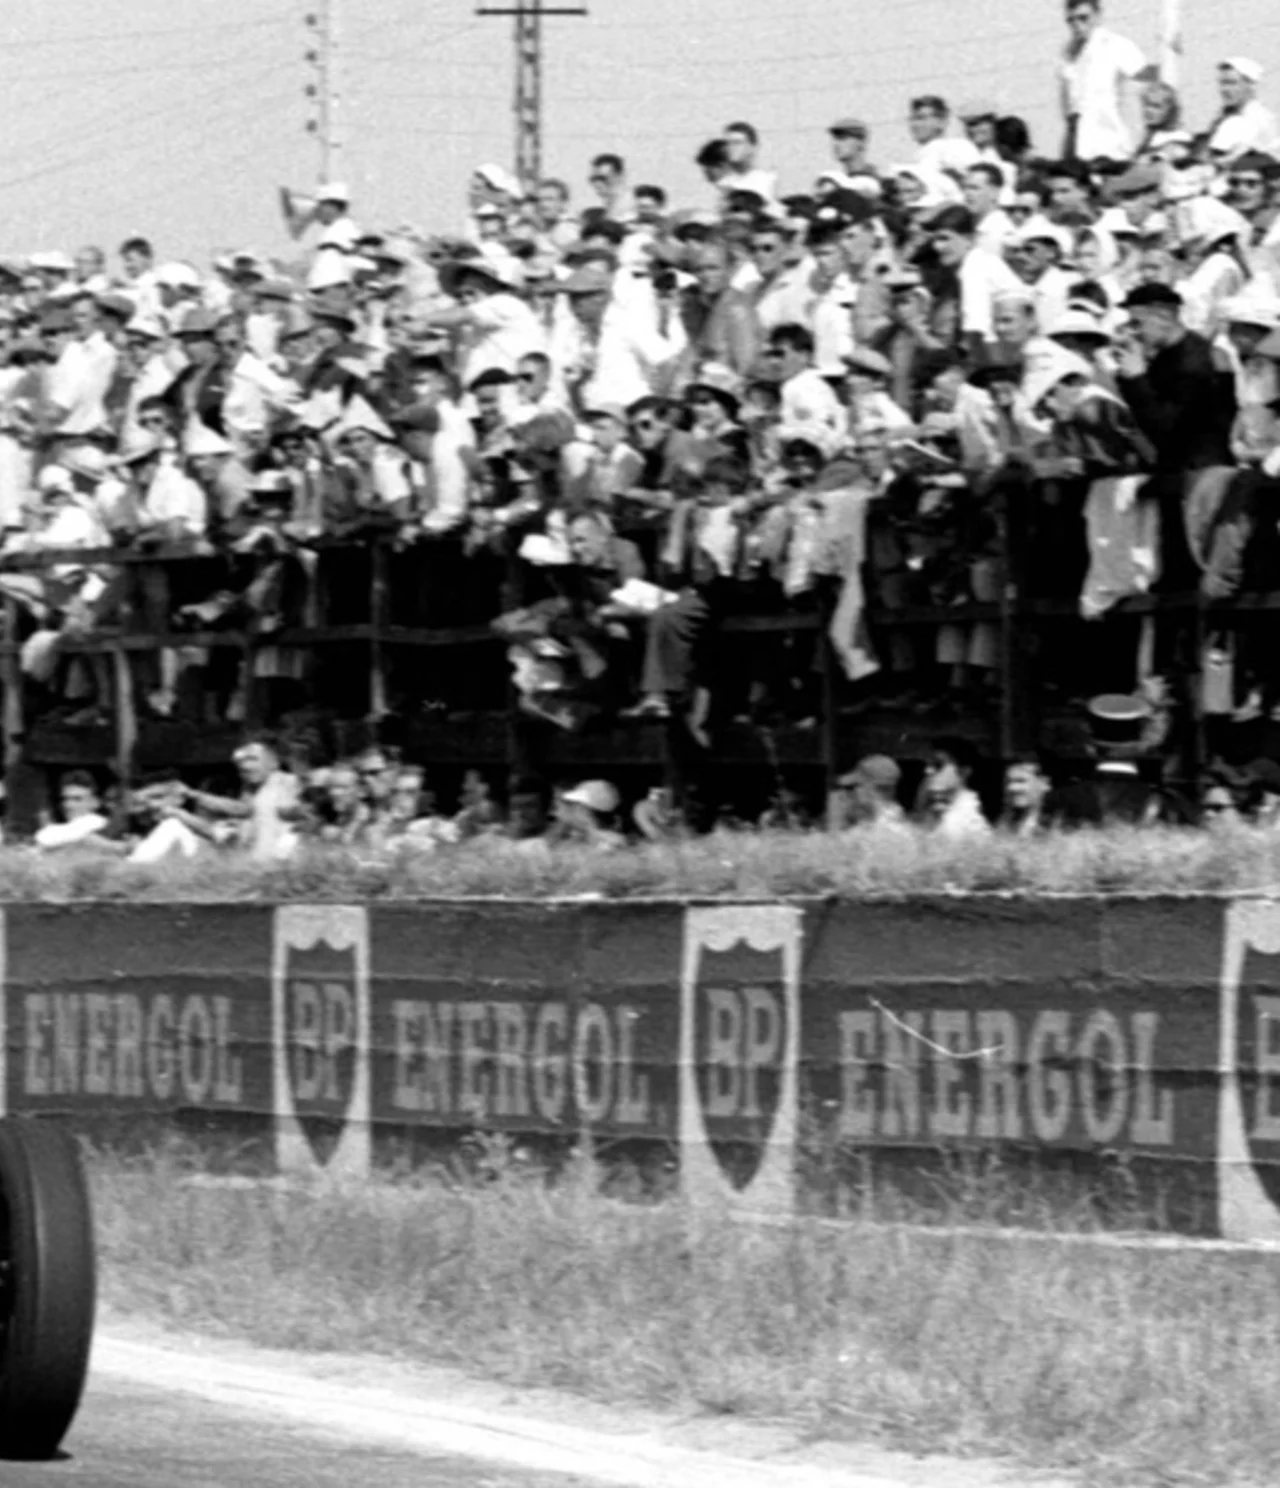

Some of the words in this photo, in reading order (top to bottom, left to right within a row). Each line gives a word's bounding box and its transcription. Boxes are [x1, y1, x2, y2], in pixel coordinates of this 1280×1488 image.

[24, 994, 240, 1101] ENERGOL
[292, 983, 354, 1100] BP
[393, 1000, 649, 1124] ENERGOL
[706, 987, 779, 1117] BP
[840, 1009, 1175, 1144] ENERGOL
